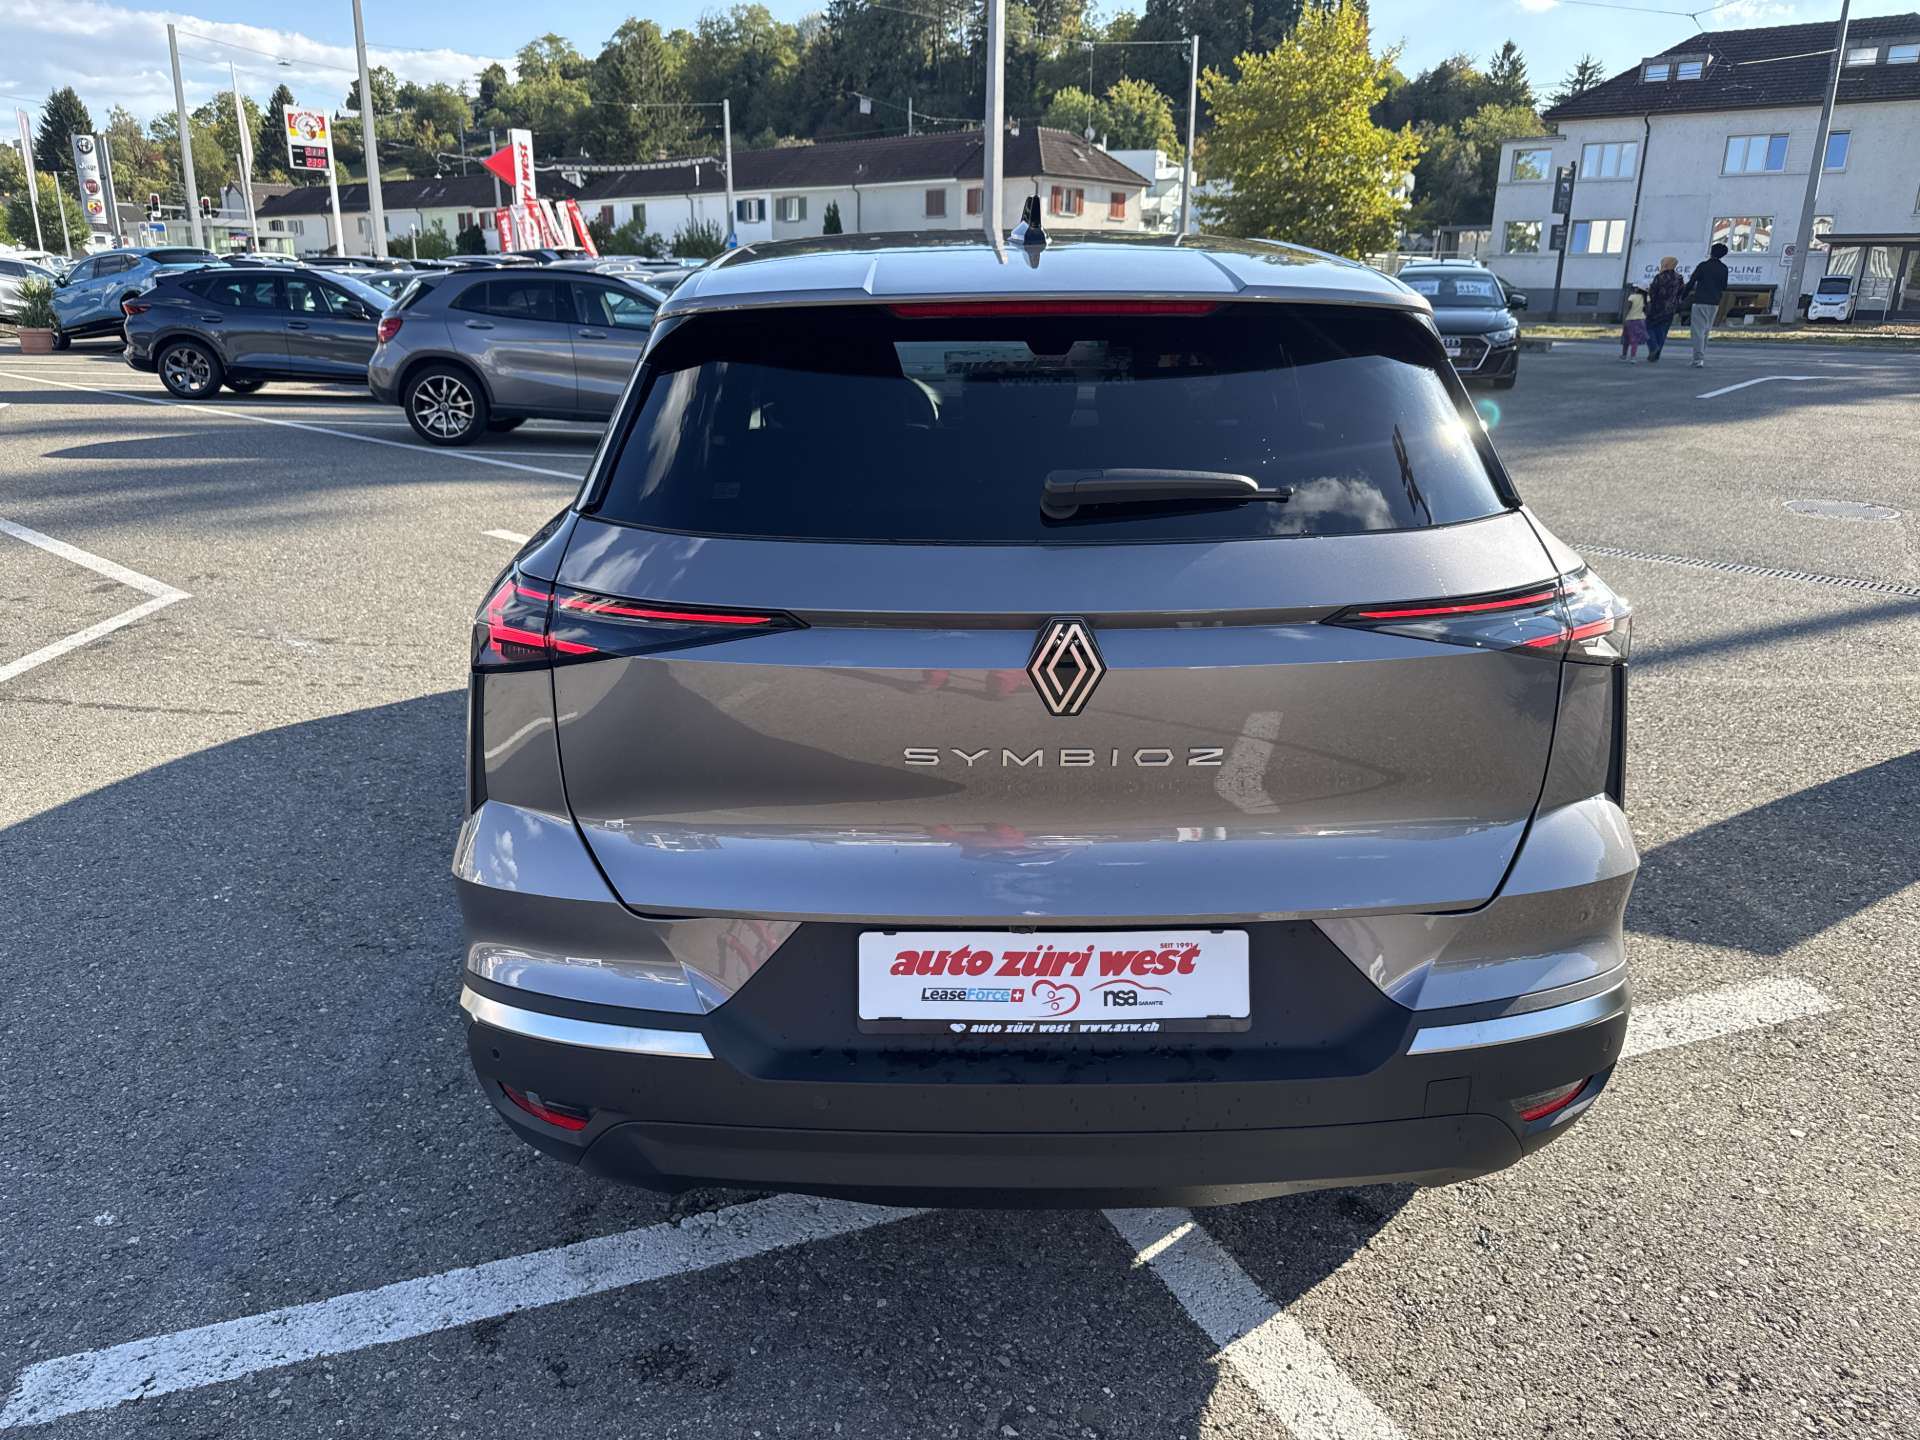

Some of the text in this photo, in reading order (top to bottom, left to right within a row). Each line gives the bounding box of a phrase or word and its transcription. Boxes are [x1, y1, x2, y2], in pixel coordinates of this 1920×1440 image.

[519, 141, 531, 181] west
[1645, 264, 1692, 273] GAGE
[903, 747, 1225, 767] SYMBIOZ
[889, 943, 1201, 976] auto züri west
[921, 987, 1011, 1001] LeaseForce
[1103, 989, 1138, 1007] nsa
[970, 1021, 1160, 1033] auto züri west www.azw.ch
